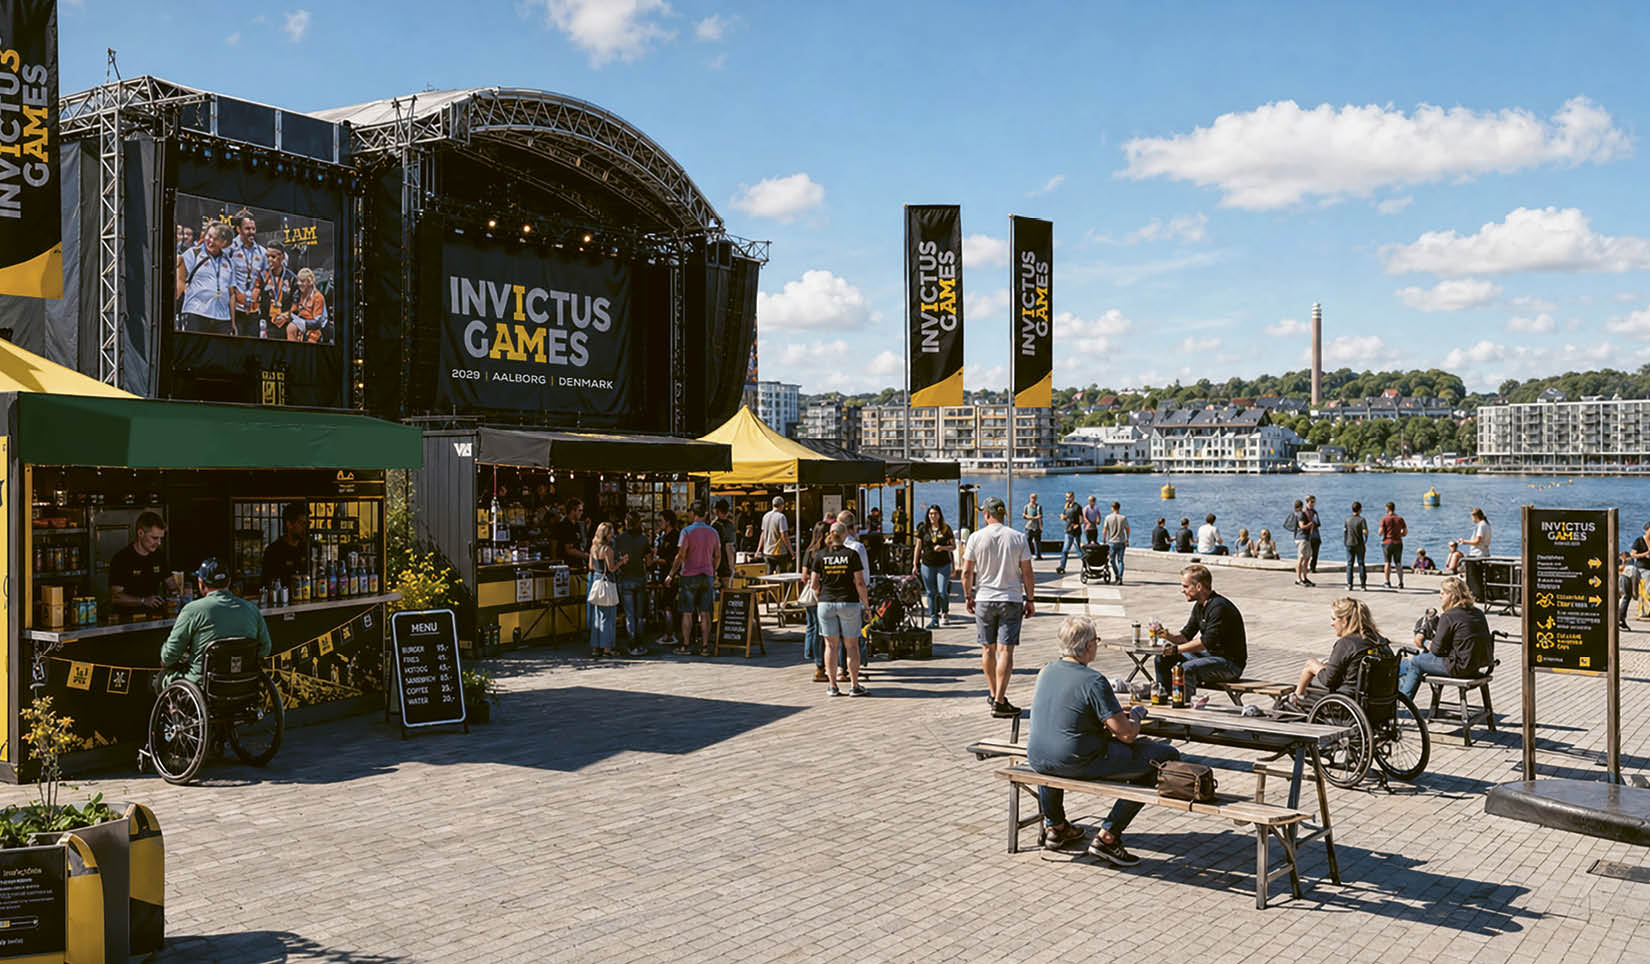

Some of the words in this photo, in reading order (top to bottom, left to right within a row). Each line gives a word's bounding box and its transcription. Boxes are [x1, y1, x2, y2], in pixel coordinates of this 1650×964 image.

[22, 63, 50, 187] GAMES
[450, 276, 612, 332] INVICTUS
[919, 241, 939, 352] INVICTUS
[939, 250, 957, 331] GAMES
[1021, 250, 1036, 356] INVICTUS
[1035, 261, 1049, 337] GAMES
[464, 320, 589, 367] GAMES
[451, 368, 481, 380] 2029
[492, 372, 546, 384] AALBORG
[558, 377, 613, 390] DENMARK
[823, 556, 848, 565] TEAM
[1547, 531, 1587, 541] GAMES
[411, 622, 437, 632] MENU
[407, 687, 428, 695] COFFEE
